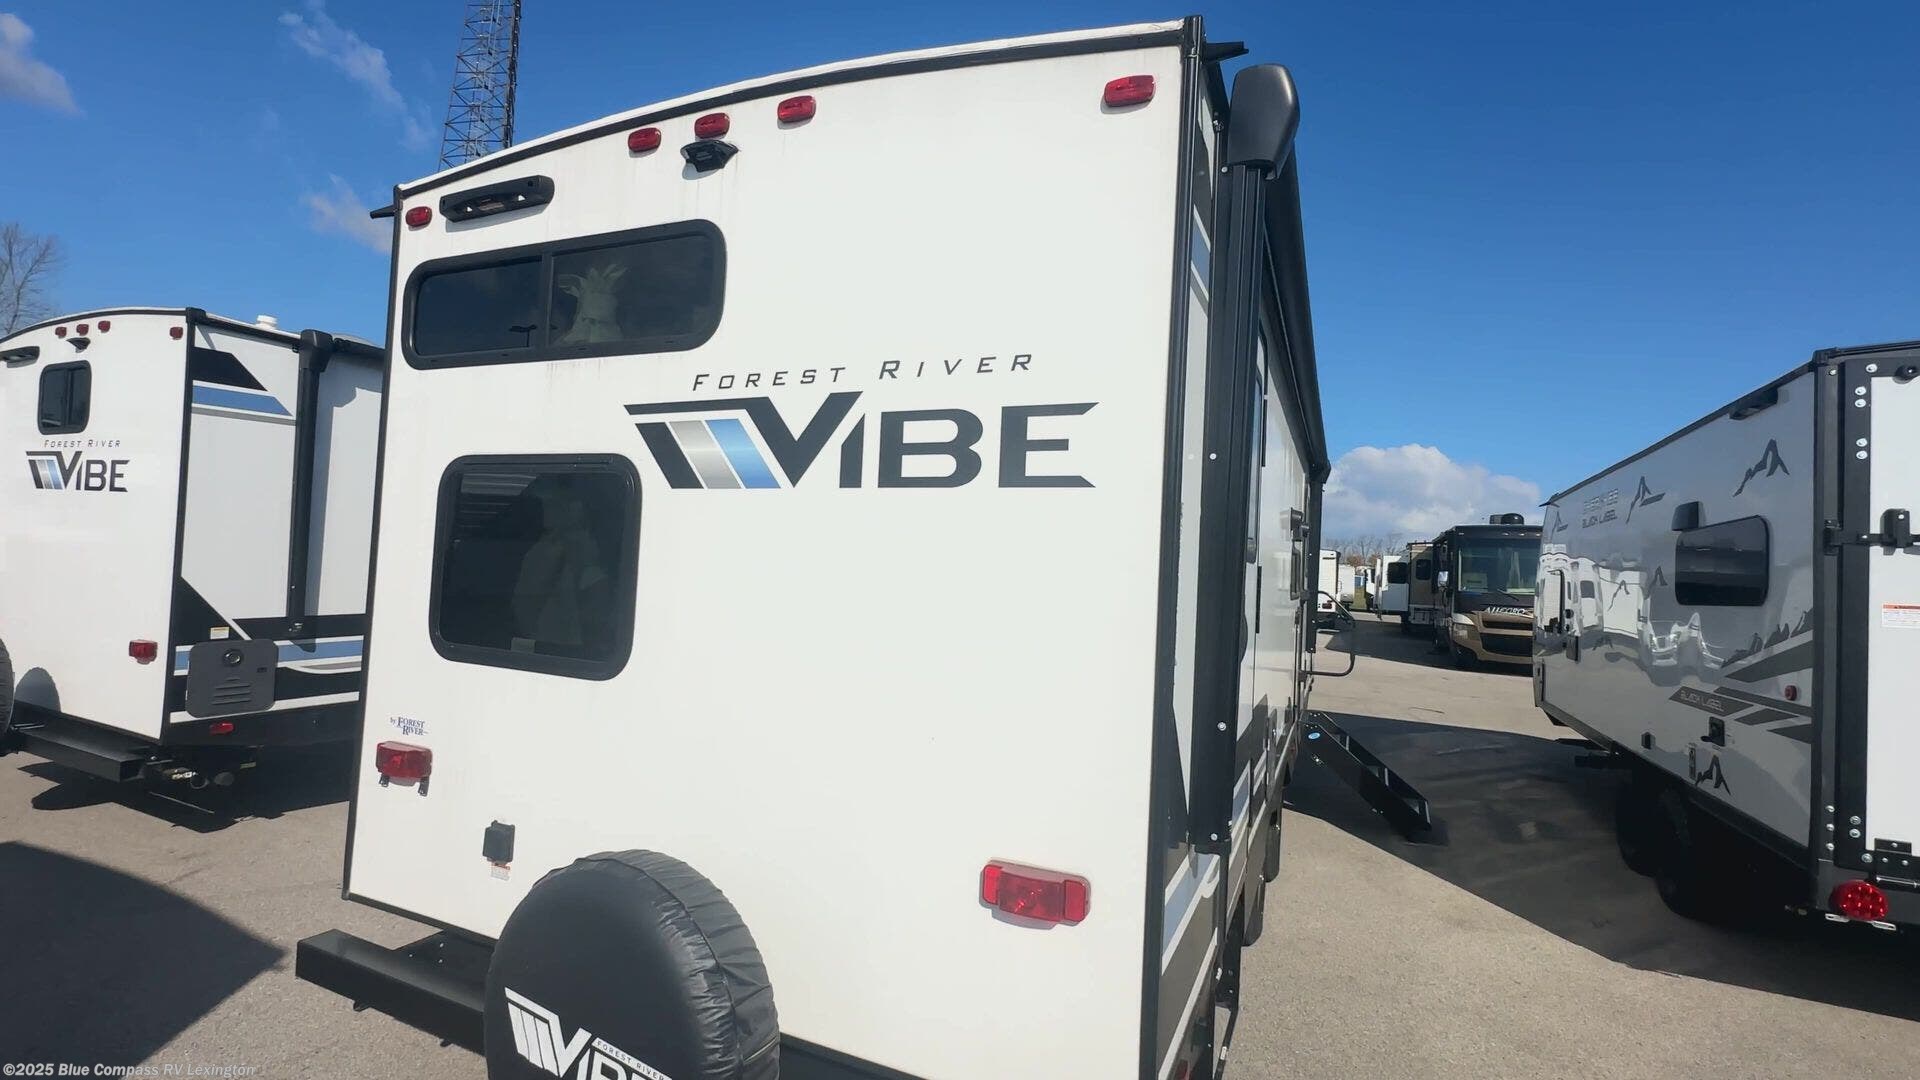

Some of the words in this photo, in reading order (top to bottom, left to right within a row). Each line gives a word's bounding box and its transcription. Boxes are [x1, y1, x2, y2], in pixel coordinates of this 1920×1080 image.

[692, 366, 848, 392] FOREST
[878, 353, 1034, 381] RIVER
[44, 439, 82, 448] FOREST
[87, 439, 121, 448] RIVER
[624, 391, 1099, 488] VIBE
[26, 450, 130, 492] VIBE
[397, 717, 425, 728] FOREST
[403, 725, 424, 735] RIVER
[596, 1040, 633, 1065] FOREST
